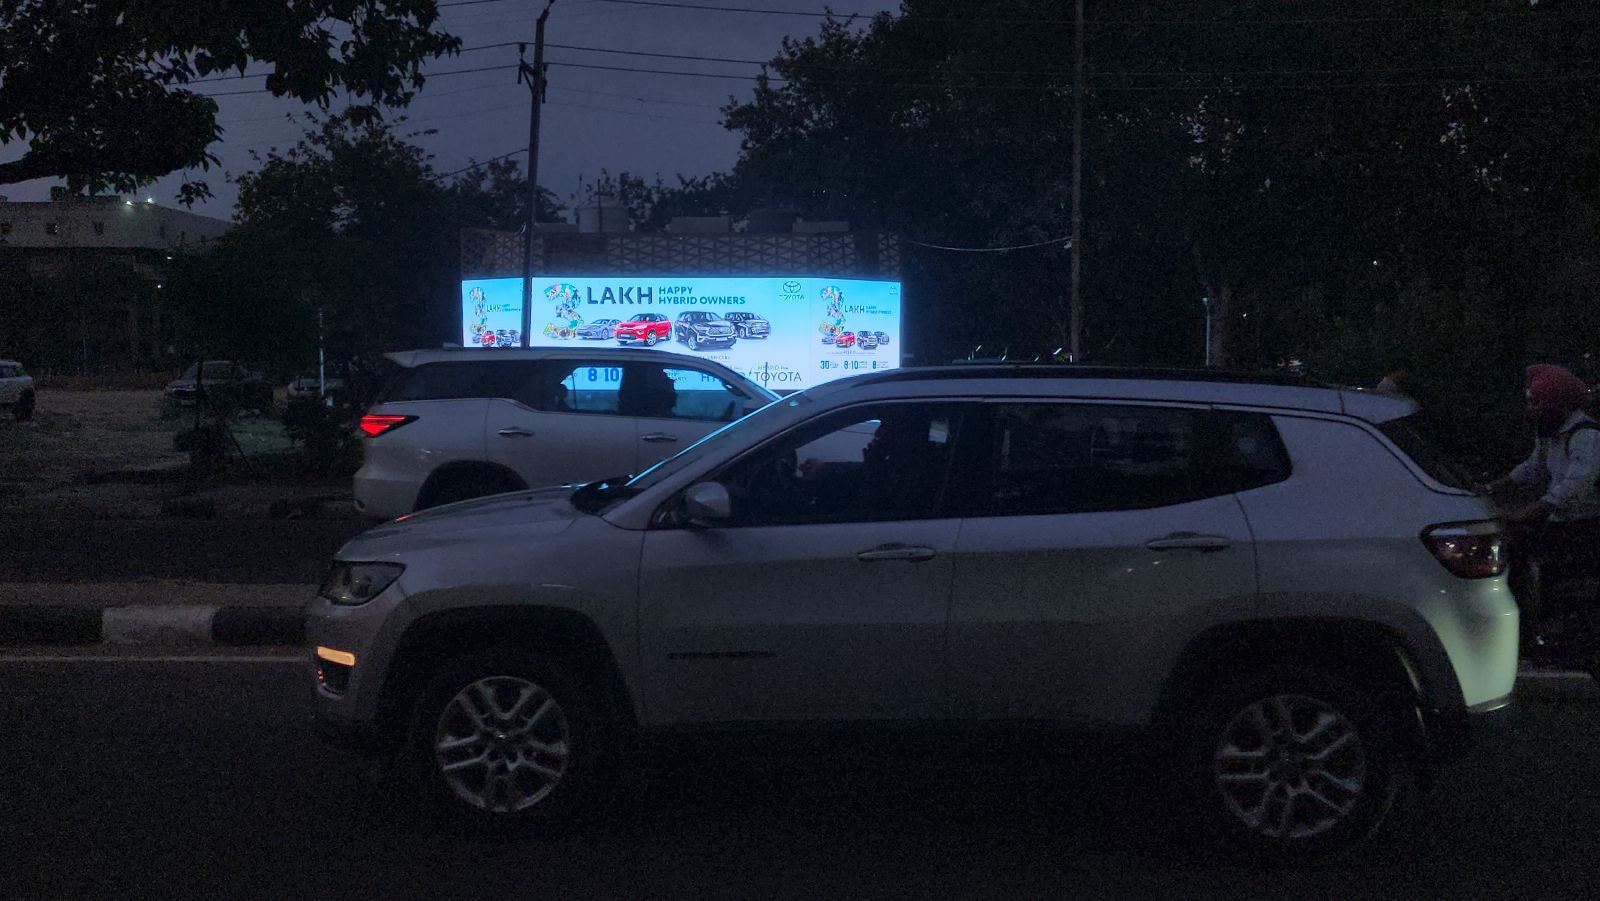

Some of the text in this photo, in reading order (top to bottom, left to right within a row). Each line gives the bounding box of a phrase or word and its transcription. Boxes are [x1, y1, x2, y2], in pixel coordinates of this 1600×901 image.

[658, 286, 693, 295] HAPPY
[586, 286, 653, 305] LAKH
[658, 296, 746, 305] HYBRID OWNERS
[844, 305, 865, 314] LAKH
[820, 360, 830, 370] 30
[753, 371, 802, 382] TOYOTA
